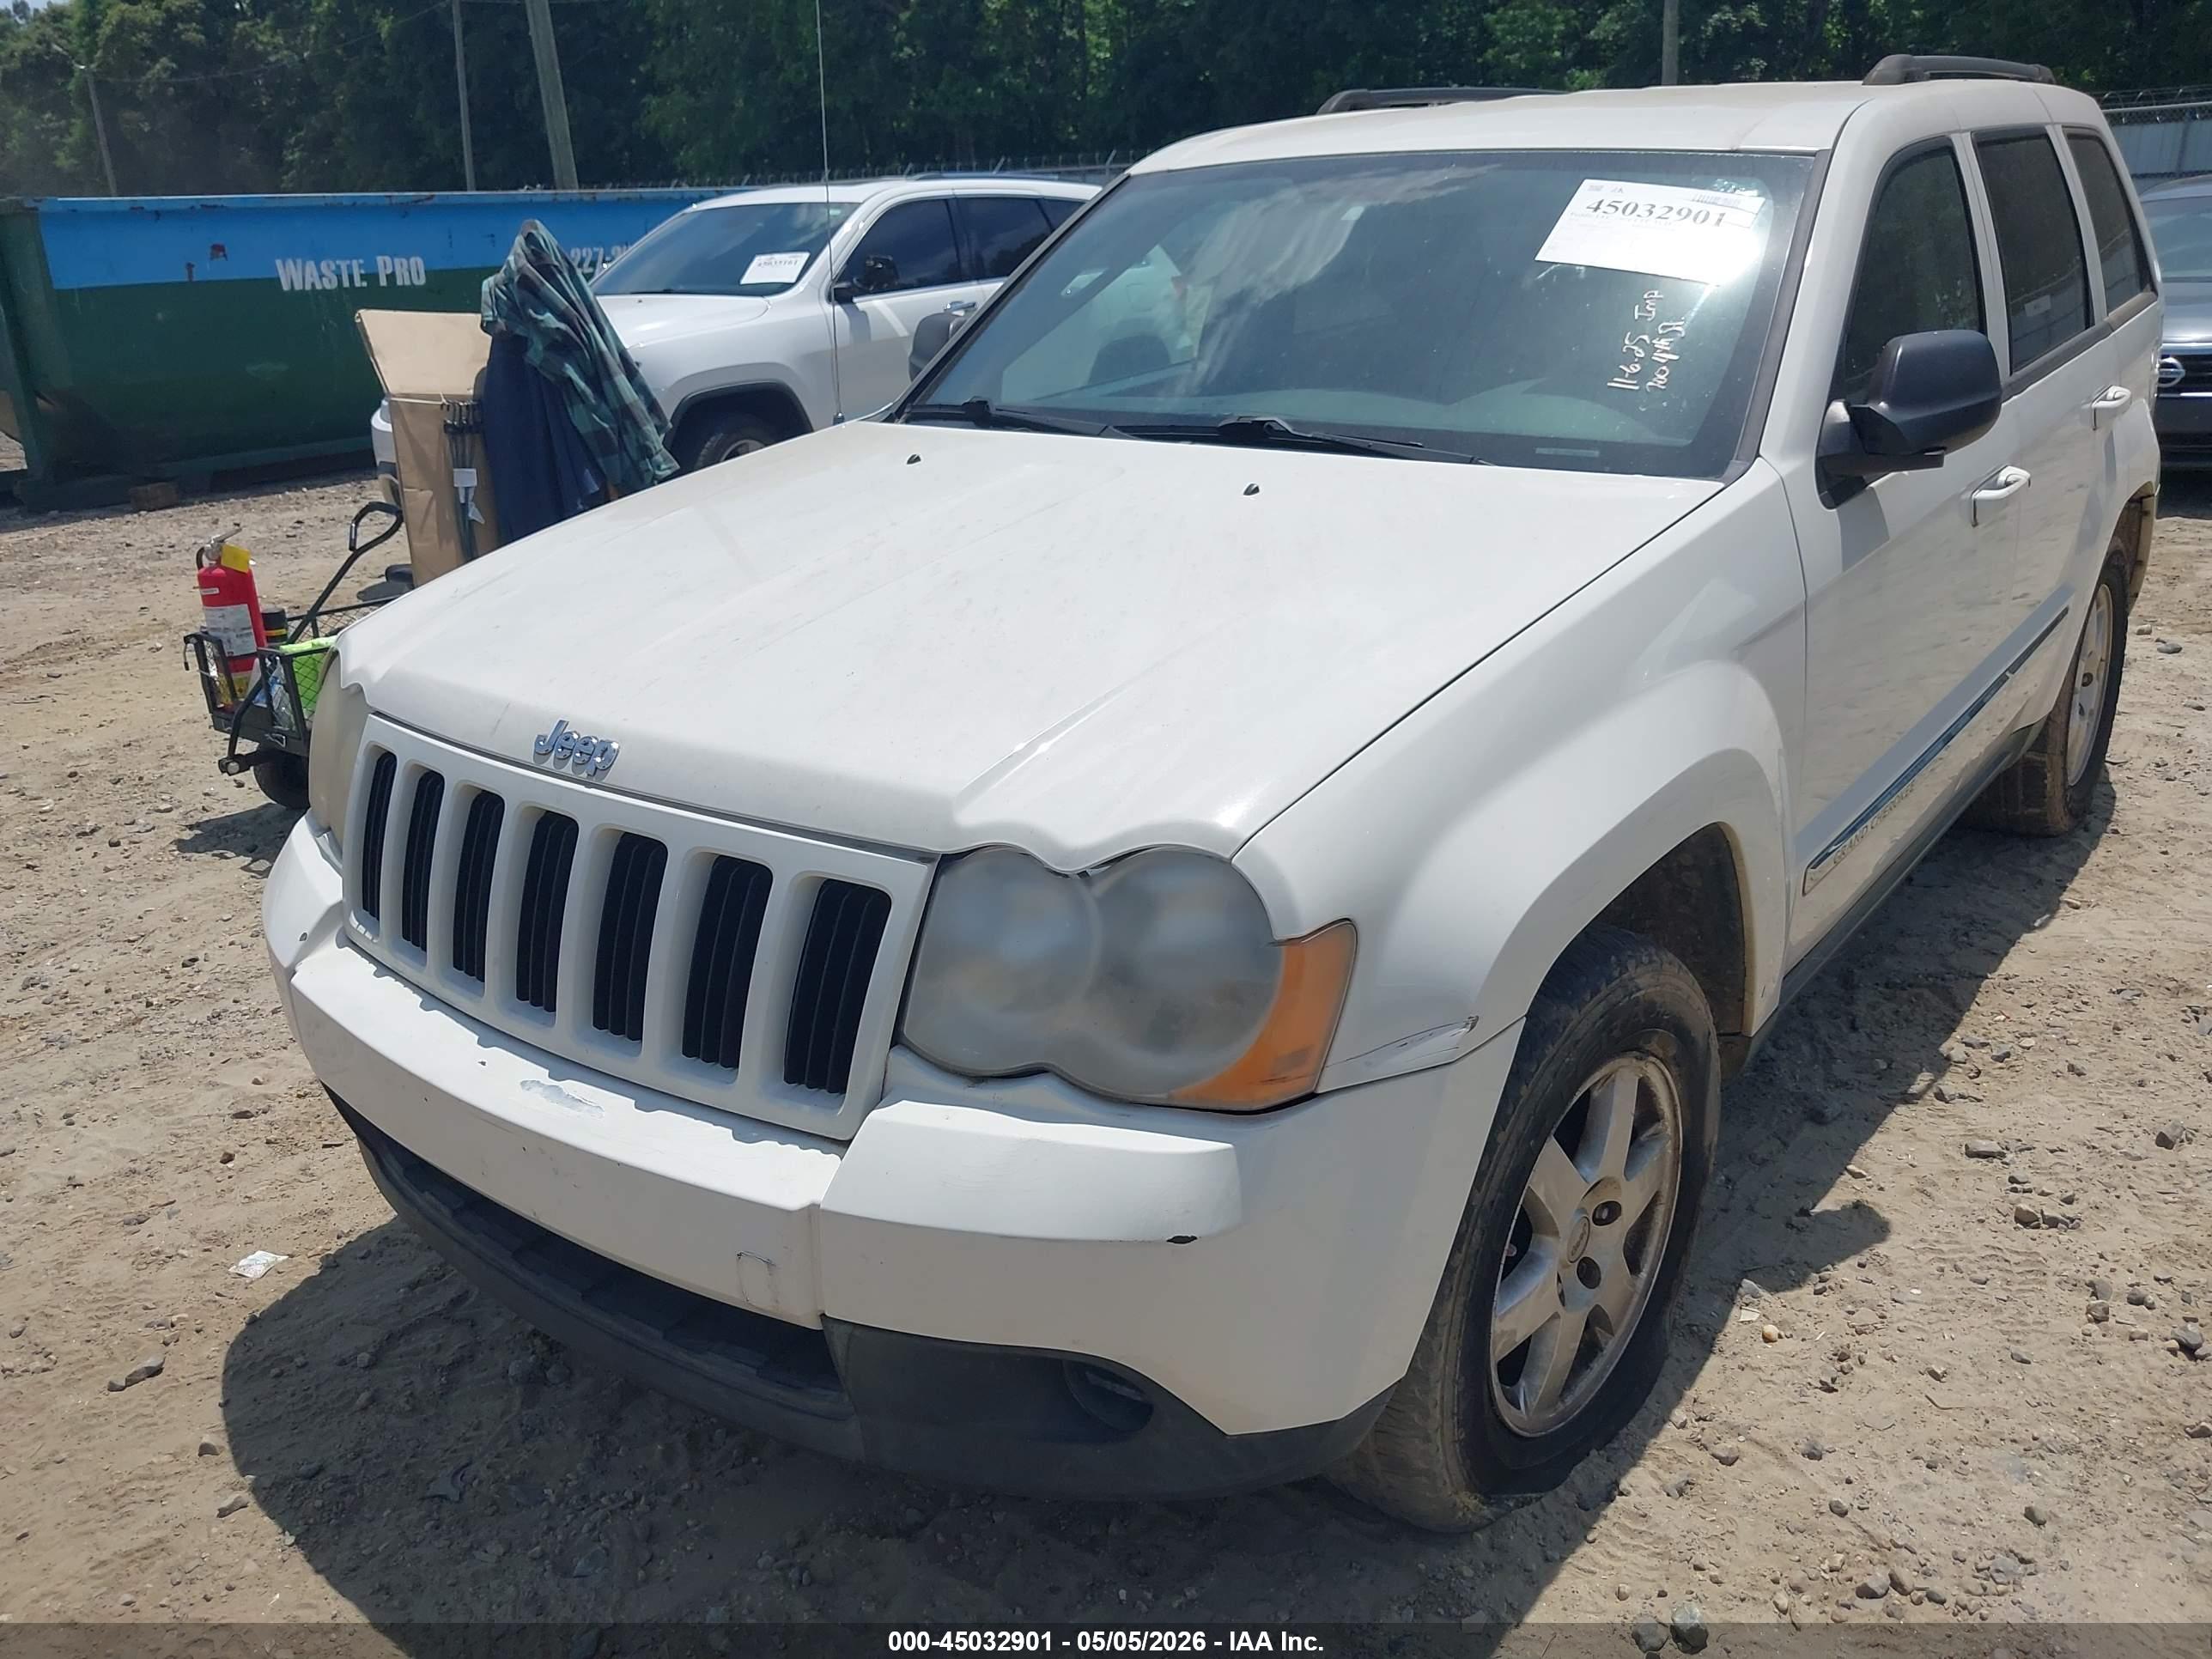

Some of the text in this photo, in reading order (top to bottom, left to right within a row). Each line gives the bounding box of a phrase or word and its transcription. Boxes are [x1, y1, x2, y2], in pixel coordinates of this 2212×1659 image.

[1586, 198, 1727, 228] 45032901
[275, 255, 427, 291] WASTE PRO
[534, 720, 619, 776] Jeep
